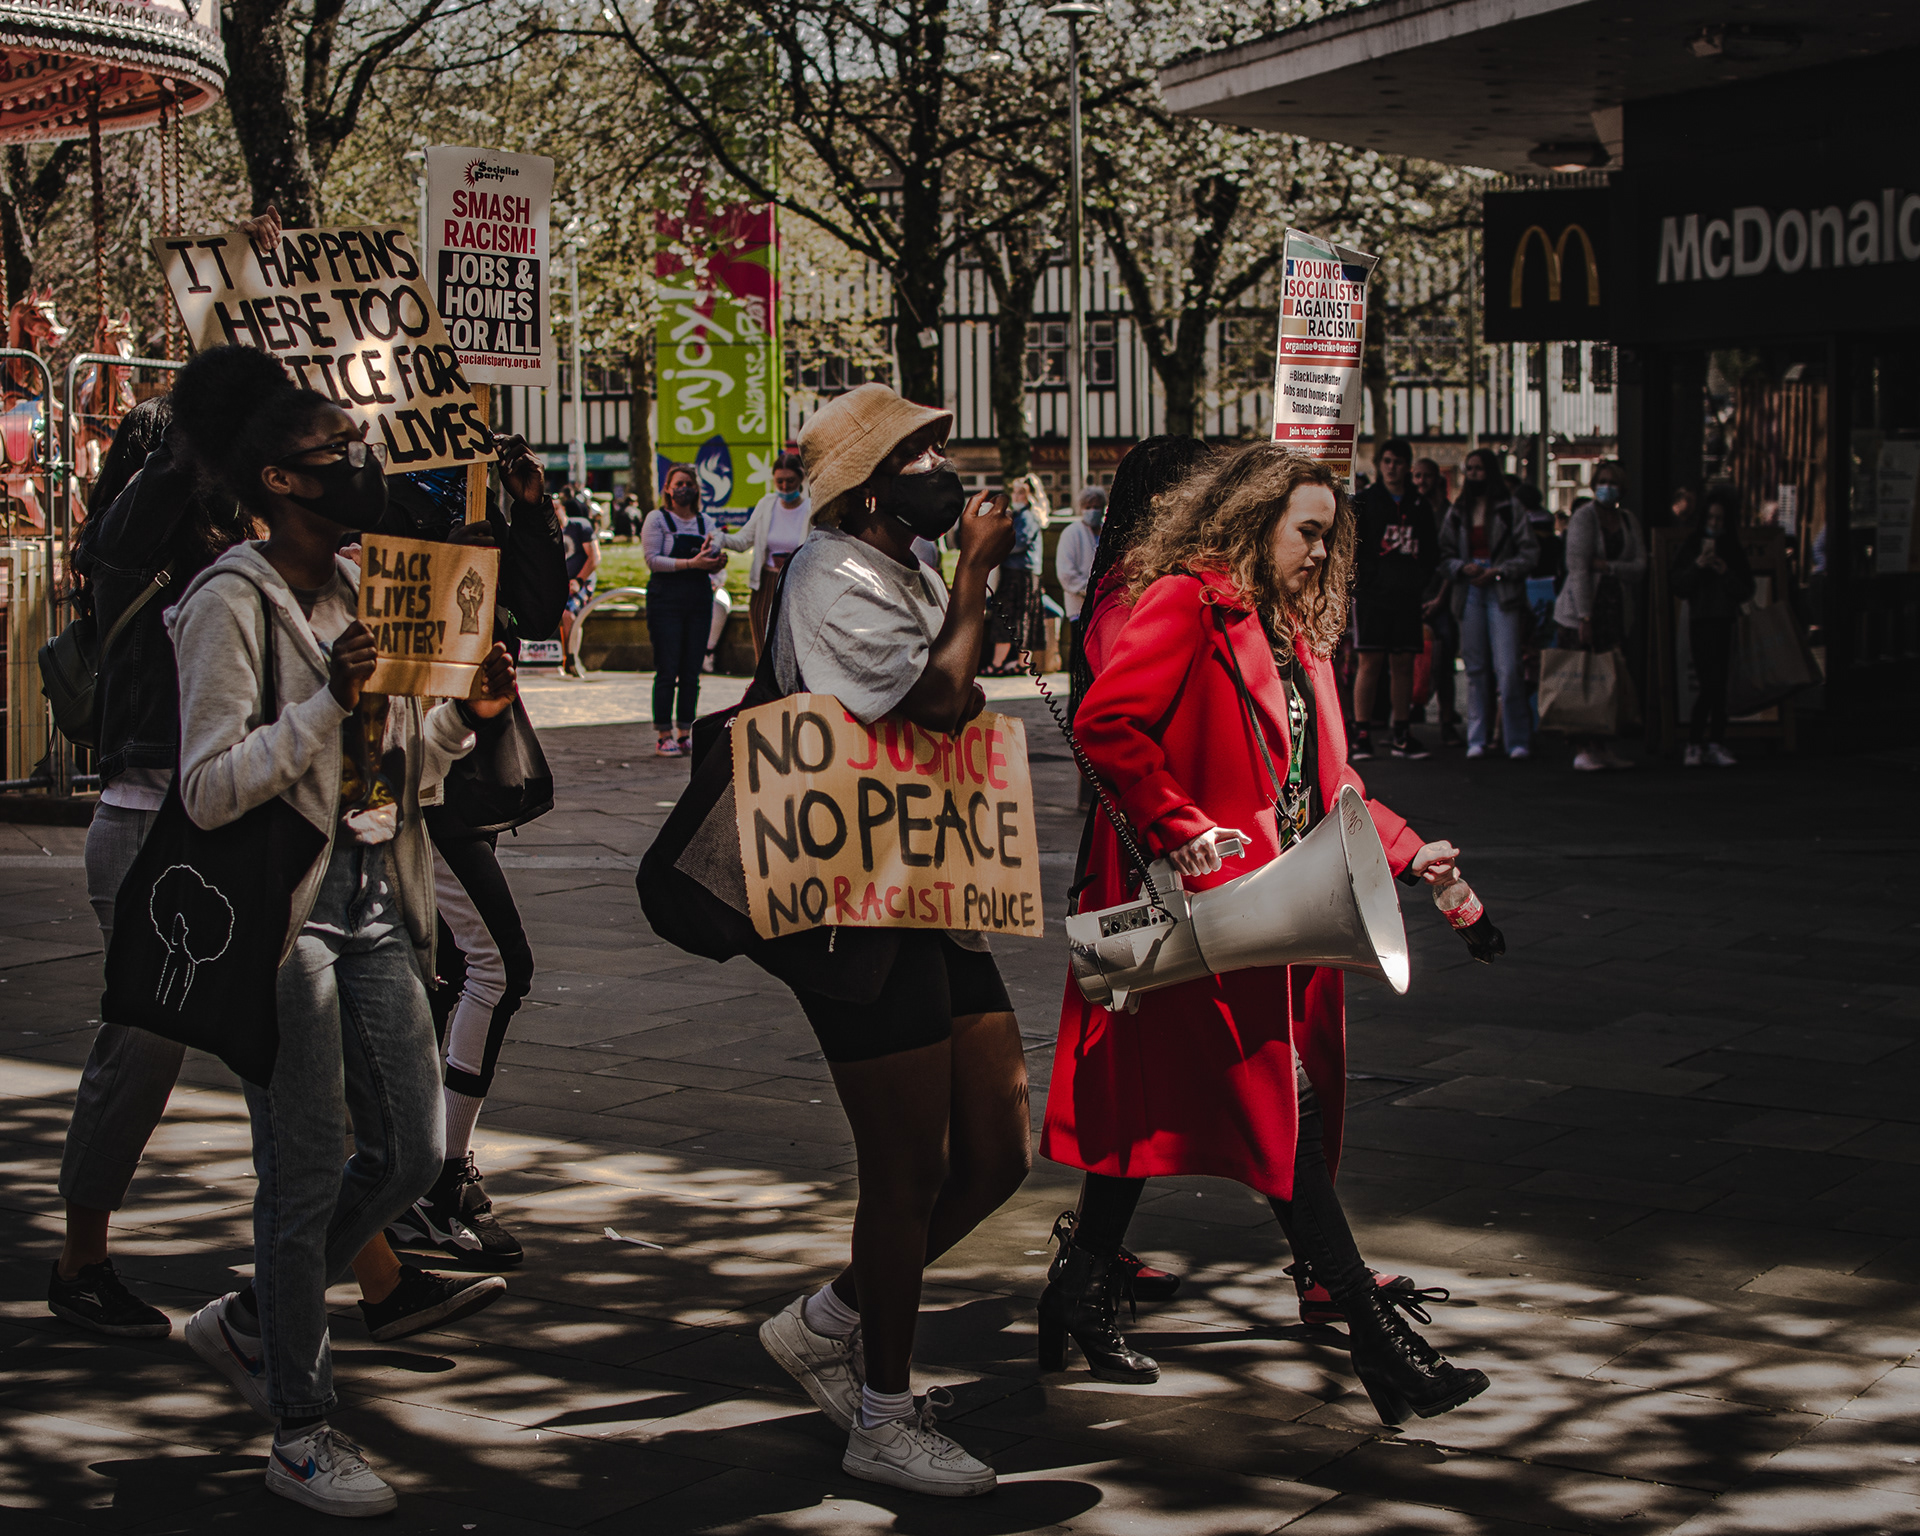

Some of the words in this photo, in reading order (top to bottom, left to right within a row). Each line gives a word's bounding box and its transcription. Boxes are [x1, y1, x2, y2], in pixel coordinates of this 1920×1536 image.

[478, 161, 520, 176] Socialist
[452, 190, 530, 224] SMASH
[444, 219, 536, 254] RACISM!
[166, 237, 235, 293] IT
[249, 230, 420, 288] HAPPENS
[445, 253, 510, 288] JOBS
[514, 260, 534, 290] &
[1295, 260, 1340, 280] YOUNG
[445, 286, 533, 321] HOMES
[1289, 279, 1359, 302] SOCIALISTS
[215, 296, 336, 350] HERE
[331, 285, 430, 341] TOO
[1295, 300, 1349, 319] AGAINST
[494, 322, 540, 354] ALL
[1308, 319, 1355, 339] RACISM
[393, 344, 471, 402] FOR
[458, 354, 541, 369] socialistparty.org.uk
[1290, 370, 1341, 386] #BlackLivesMatter
[1283, 384, 1295, 397] Jobs
[1296, 388, 1307, 399] and
[1308, 388, 1328, 401] homes
[1328, 391, 1336, 403] for
[1292, 401, 1312, 415] Smash
[1313, 405, 1341, 419] capitalism
[378, 403, 495, 463] LIVES
[1289, 426, 1299, 437] Join
[1300, 427, 1318, 438] Young
[1318, 427, 1340, 436] Socialists
[368, 546, 431, 582] BLACK
[366, 585, 431, 619] LIVES
[746, 710, 835, 794] NO
[843, 711, 1009, 790] JUSTICE
[753, 789, 848, 879] NO
[858, 777, 1022, 872] PEACE
[767, 877, 828, 937] NO
[833, 876, 956, 927] RACIST
[963, 883, 1036, 930] POLICE
